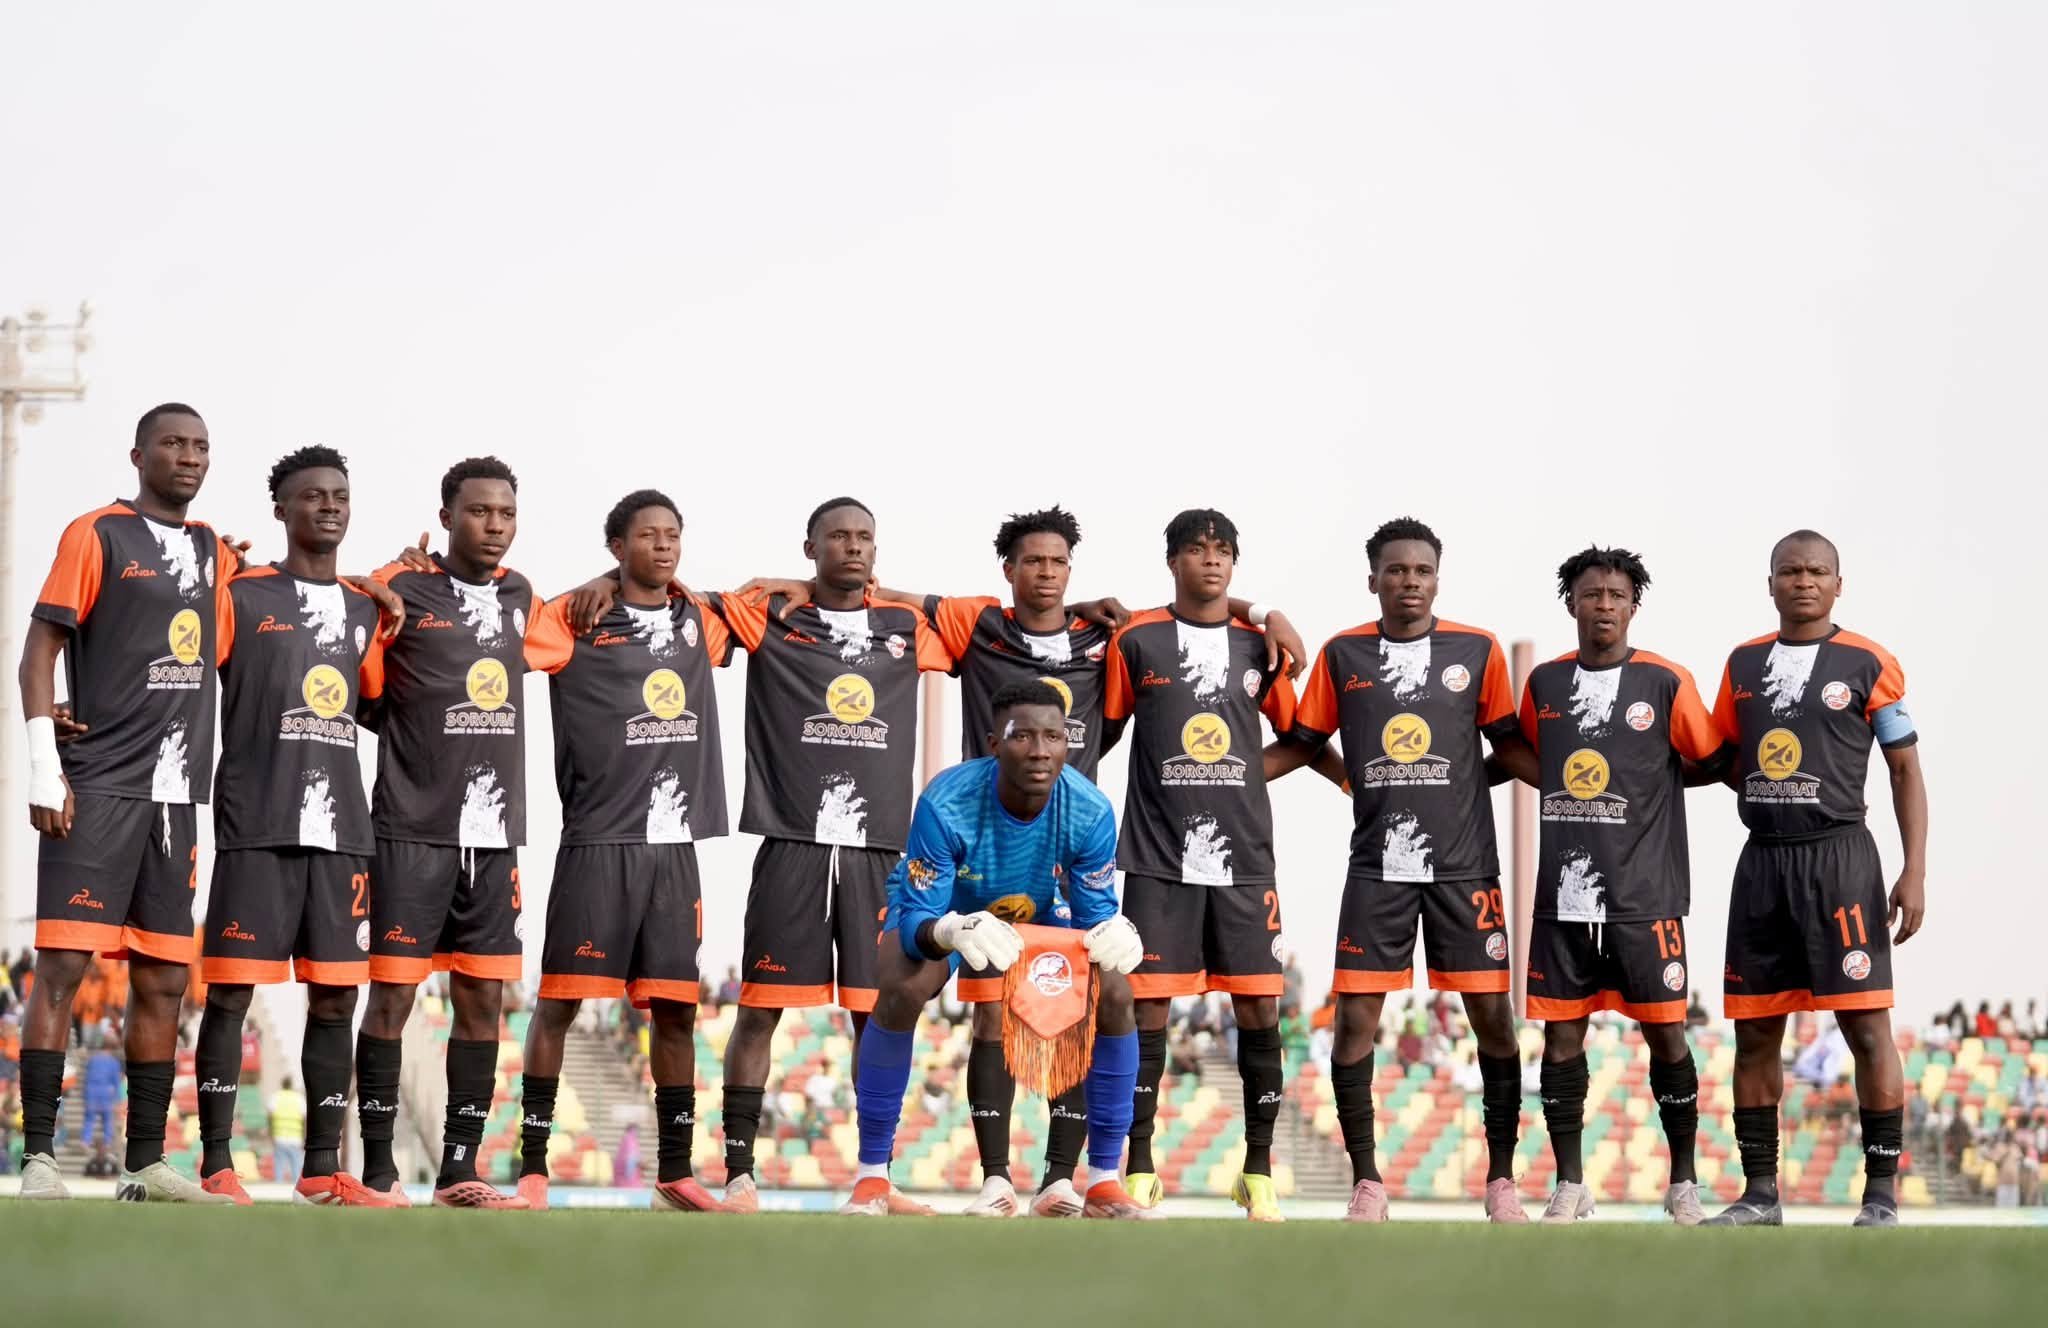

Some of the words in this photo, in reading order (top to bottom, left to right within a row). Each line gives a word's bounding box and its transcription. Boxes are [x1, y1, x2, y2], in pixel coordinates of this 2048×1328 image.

[121, 561, 157, 579] PANGA
[257, 615, 294, 632] PANGA
[417, 612, 453, 629] PANGA
[1344, 674, 1374, 692] PANGA
[281, 717, 355, 740] SOROUBA
[626, 720, 698, 738] SOROUBAT
[803, 721, 888, 742] SOROUBAT
[1162, 764, 1247, 779] SOROUBAT
[1364, 763, 1450, 781] SOROUBAT
[1542, 799, 1628, 817] SOROUBAT
[68, 888, 104, 909] PANGA
[352, 872, 370, 917] 2
[1471, 888, 1505, 930] 29
[221, 921, 256, 941] PANGA
[1834, 903, 1868, 947] 11
[384, 925, 417, 945] PANGA
[1651, 919, 1682, 959] 13
[319, 1093, 349, 1107] PAN
[459, 1104, 488, 1118] PANG
